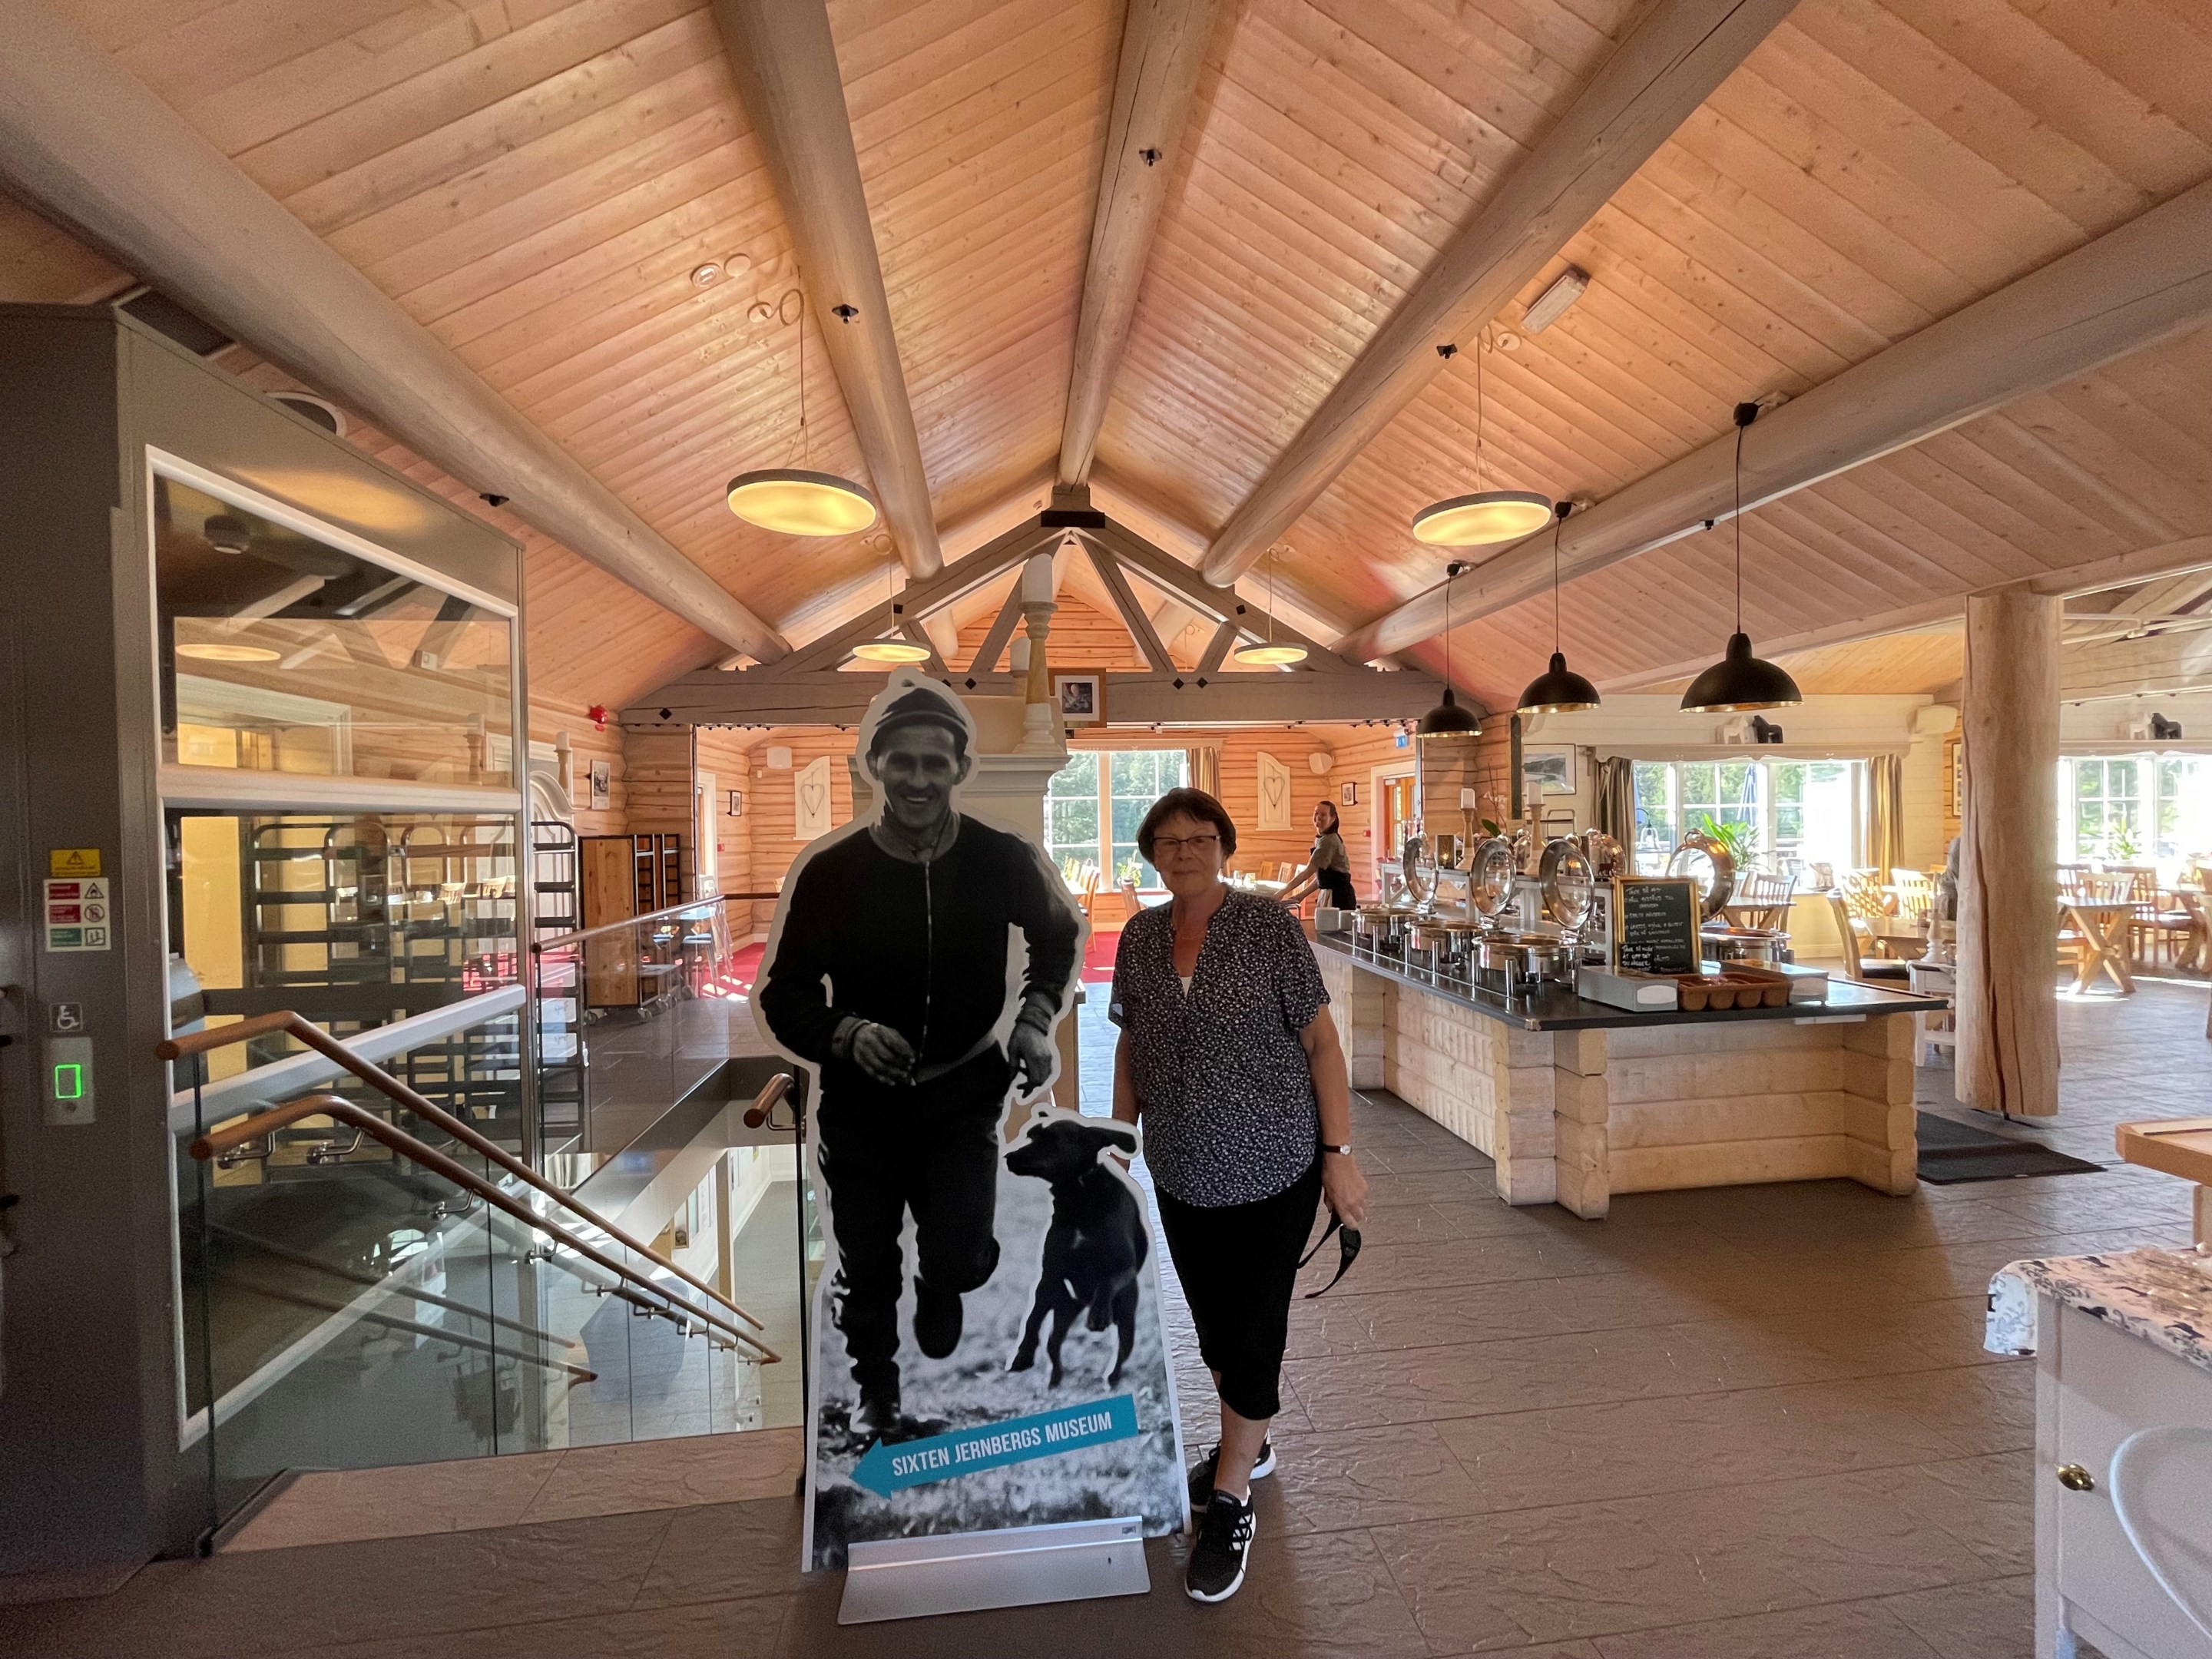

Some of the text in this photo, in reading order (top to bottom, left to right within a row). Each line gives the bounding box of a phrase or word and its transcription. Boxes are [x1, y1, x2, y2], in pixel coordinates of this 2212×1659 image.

[892, 1412, 1112, 1476] SIXTEN JERNBERGS MUSEUM
